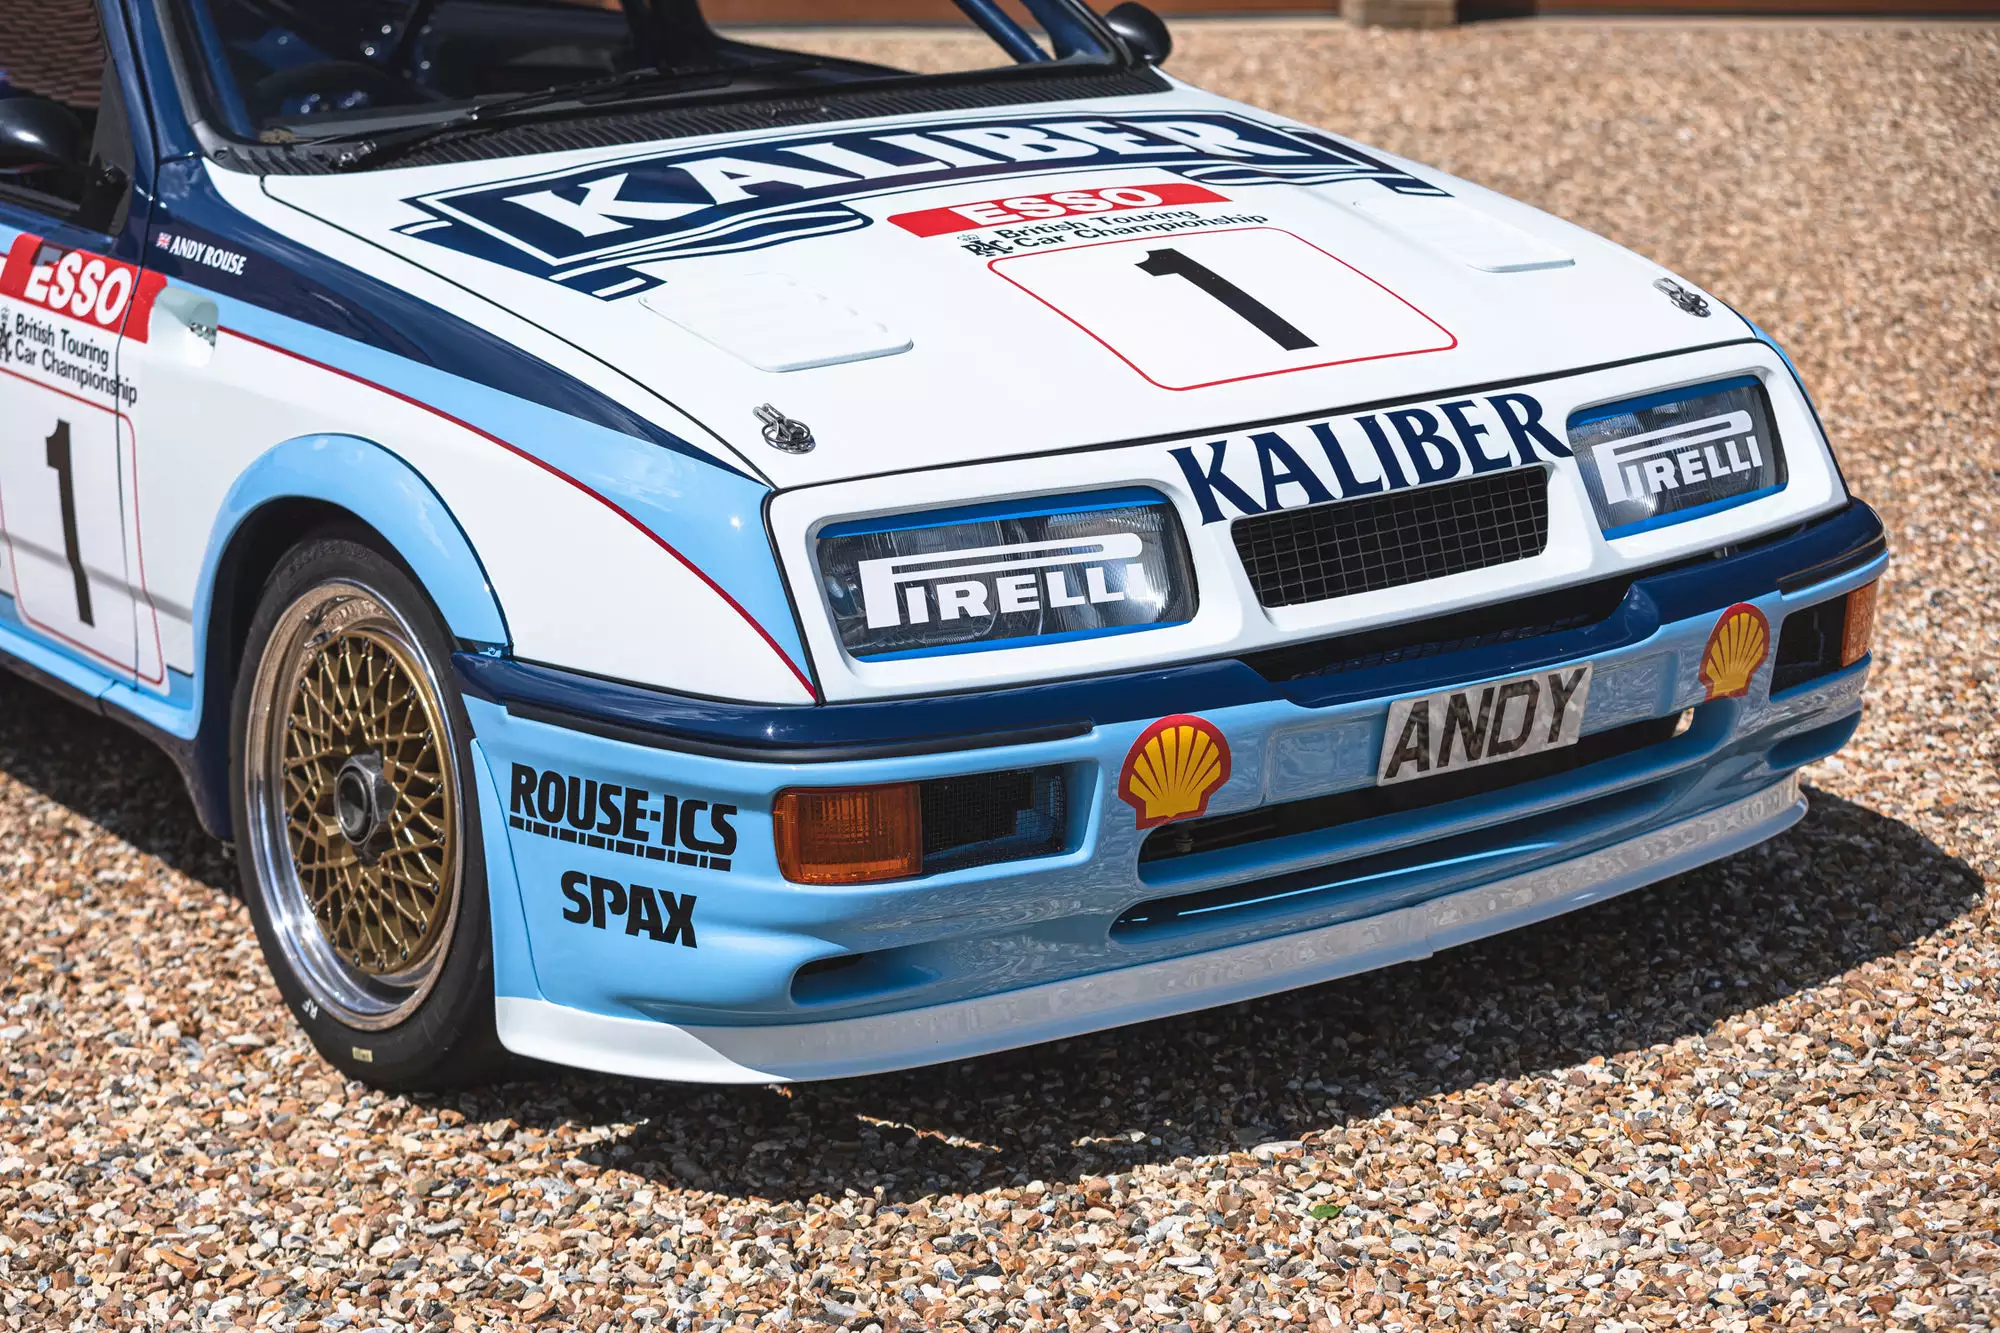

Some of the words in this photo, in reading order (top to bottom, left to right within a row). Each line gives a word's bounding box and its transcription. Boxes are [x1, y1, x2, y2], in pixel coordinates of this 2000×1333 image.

[502, 120, 1312, 237] KALIBER
[948, 187, 1163, 226] ESSO
[170, 235, 206, 261] ANDY
[203, 247, 247, 276] ROUSE
[994, 219, 1089, 240] British
[1090, 208, 1200, 230] Touring
[1013, 233, 1068, 248] Car
[1073, 213, 1270, 239] Championship
[24, 252, 132, 325] ESSO
[1135, 248, 1318, 351] 1
[15, 312, 55, 347] British
[61, 328, 109, 371] Touring
[15, 338, 37, 366] Car
[42, 348, 137, 407] Championship
[1167, 393, 1574, 526] KALIBER
[1591, 409, 1763, 505] PIRELLI
[45, 418, 95, 628] 1
[858, 532, 1146, 629] PIRELLI
[1383, 667, 1587, 780] ANDY
[510, 762, 737, 856] ROUSE-ICS
[560, 869, 697, 948] SPAX
